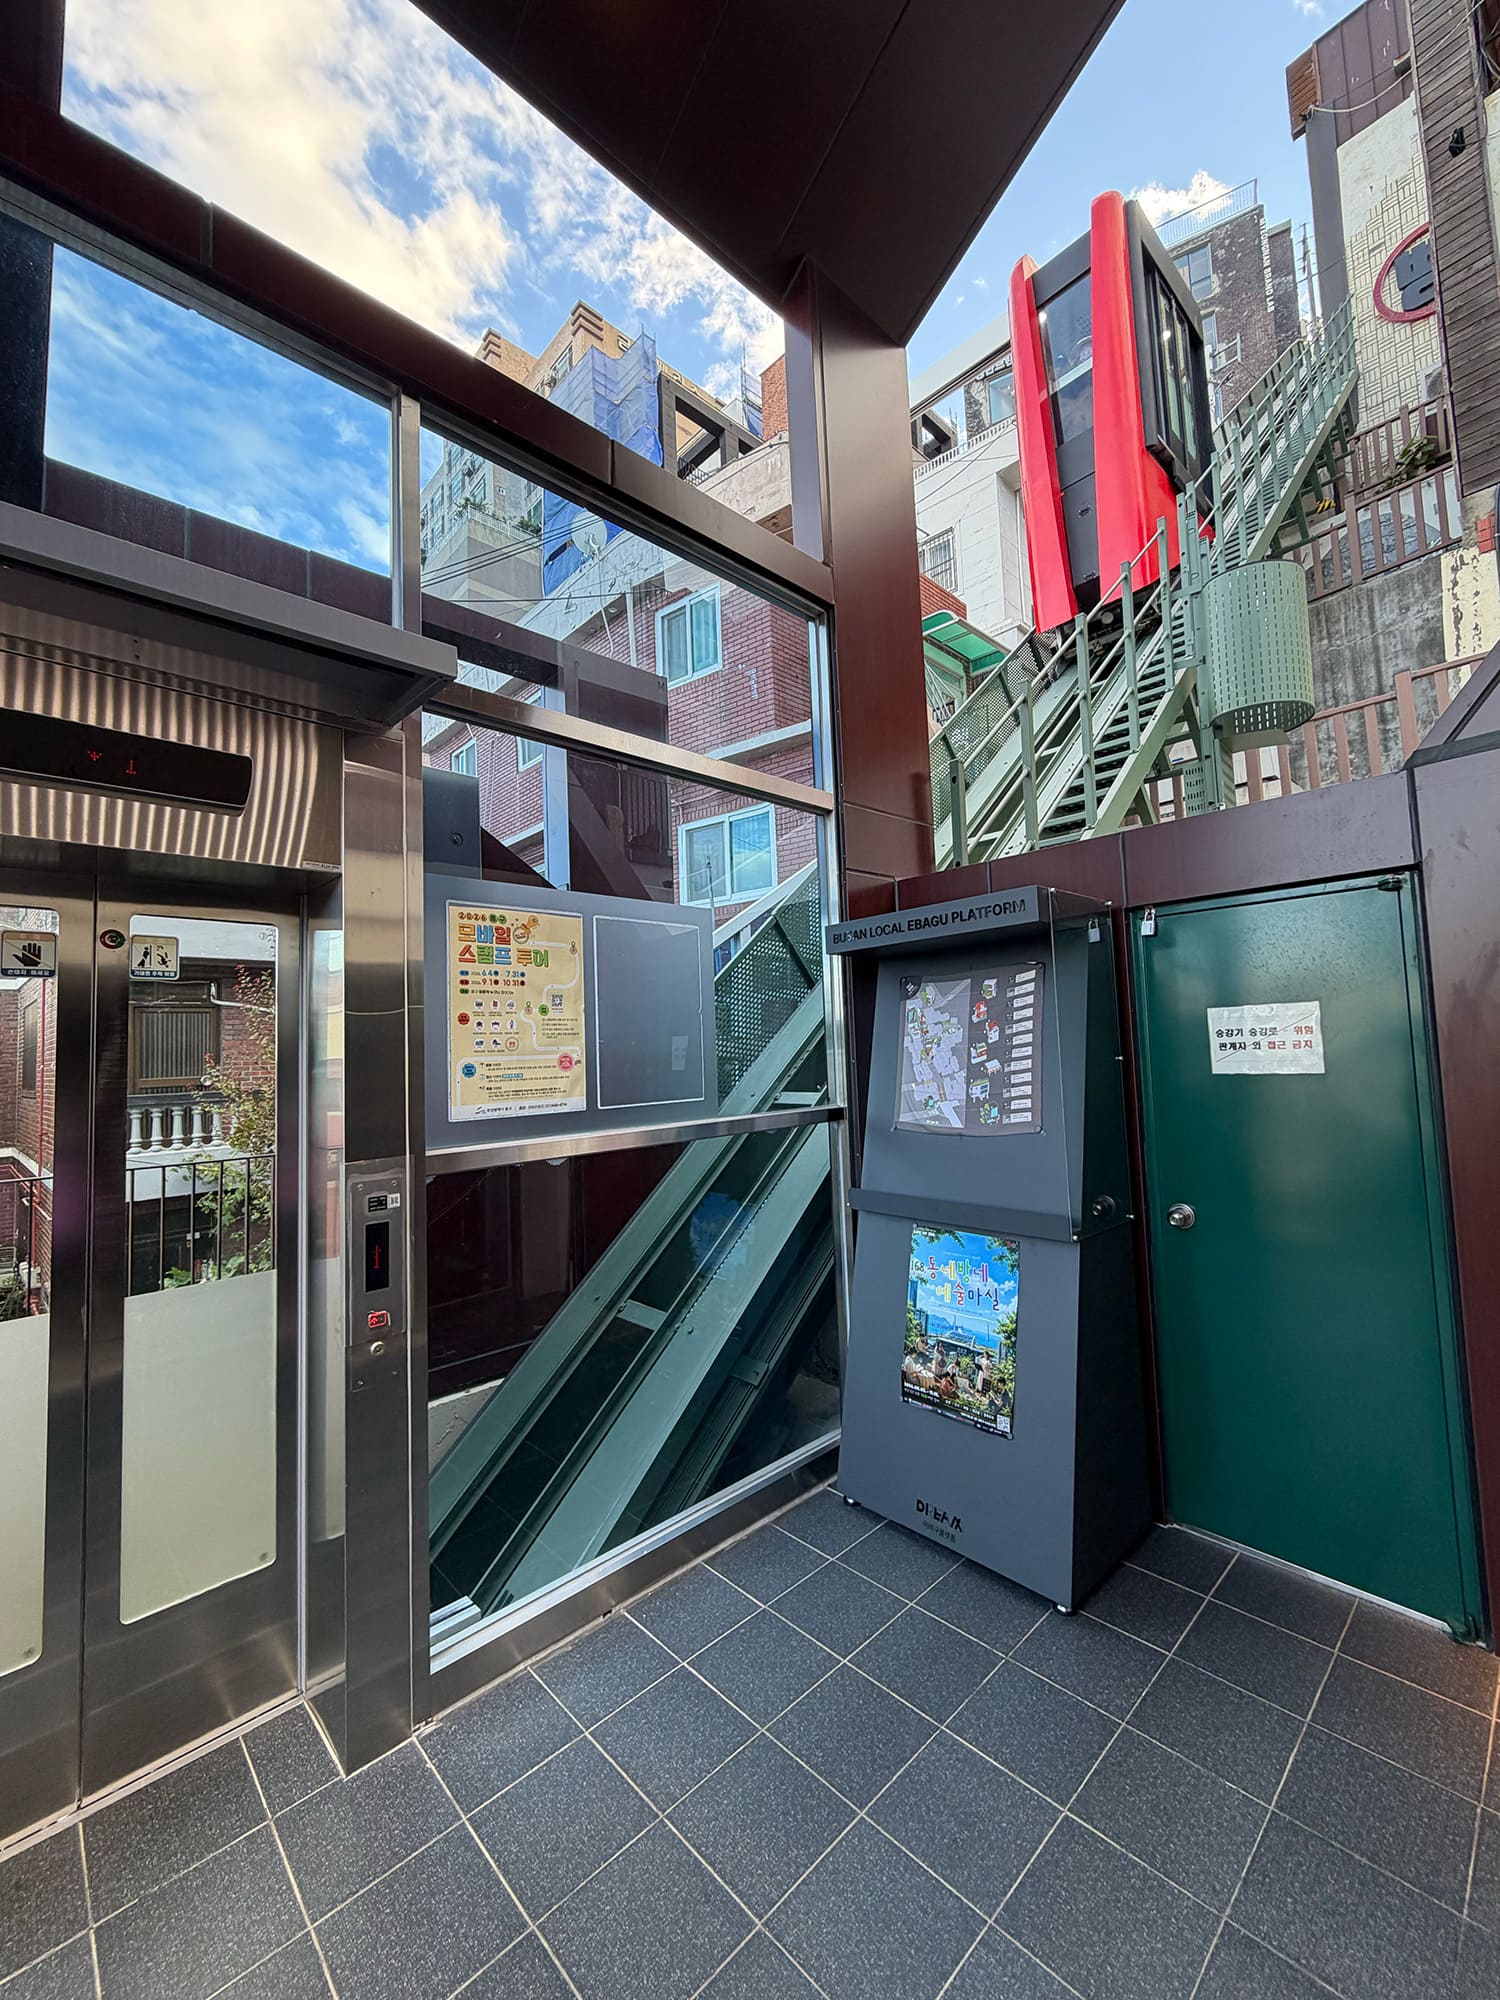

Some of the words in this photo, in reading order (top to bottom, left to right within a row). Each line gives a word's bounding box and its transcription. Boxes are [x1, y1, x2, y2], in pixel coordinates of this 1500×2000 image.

[1264, 267, 1273, 295] BRAND
[1266, 296, 1274, 312] LAB
[833, 929, 867, 944] BUSAN
[869, 922, 904, 938] LOCAL
[907, 913, 948, 931] EBAGU
[951, 899, 1026, 923] PLATFORM
[458, 923, 511, 945] 모바일
[458, 945, 511, 965] 스탬프
[516, 948, 549, 967] 투어
[1216, 1028, 1244, 1038] 승강기
[1249, 1027, 1278, 1037] 승강로
[1293, 1025, 1314, 1035] 위험
[1219, 1042, 1247, 1051] 관계자
[1252, 1041, 1261, 1050] 외
[1267, 1040, 1286, 1050] 접근
[1292, 1040, 1313, 1049] 금지
[927, 1256, 988, 1283] 동네방네
[936, 1281, 999, 1311] 예술마실
